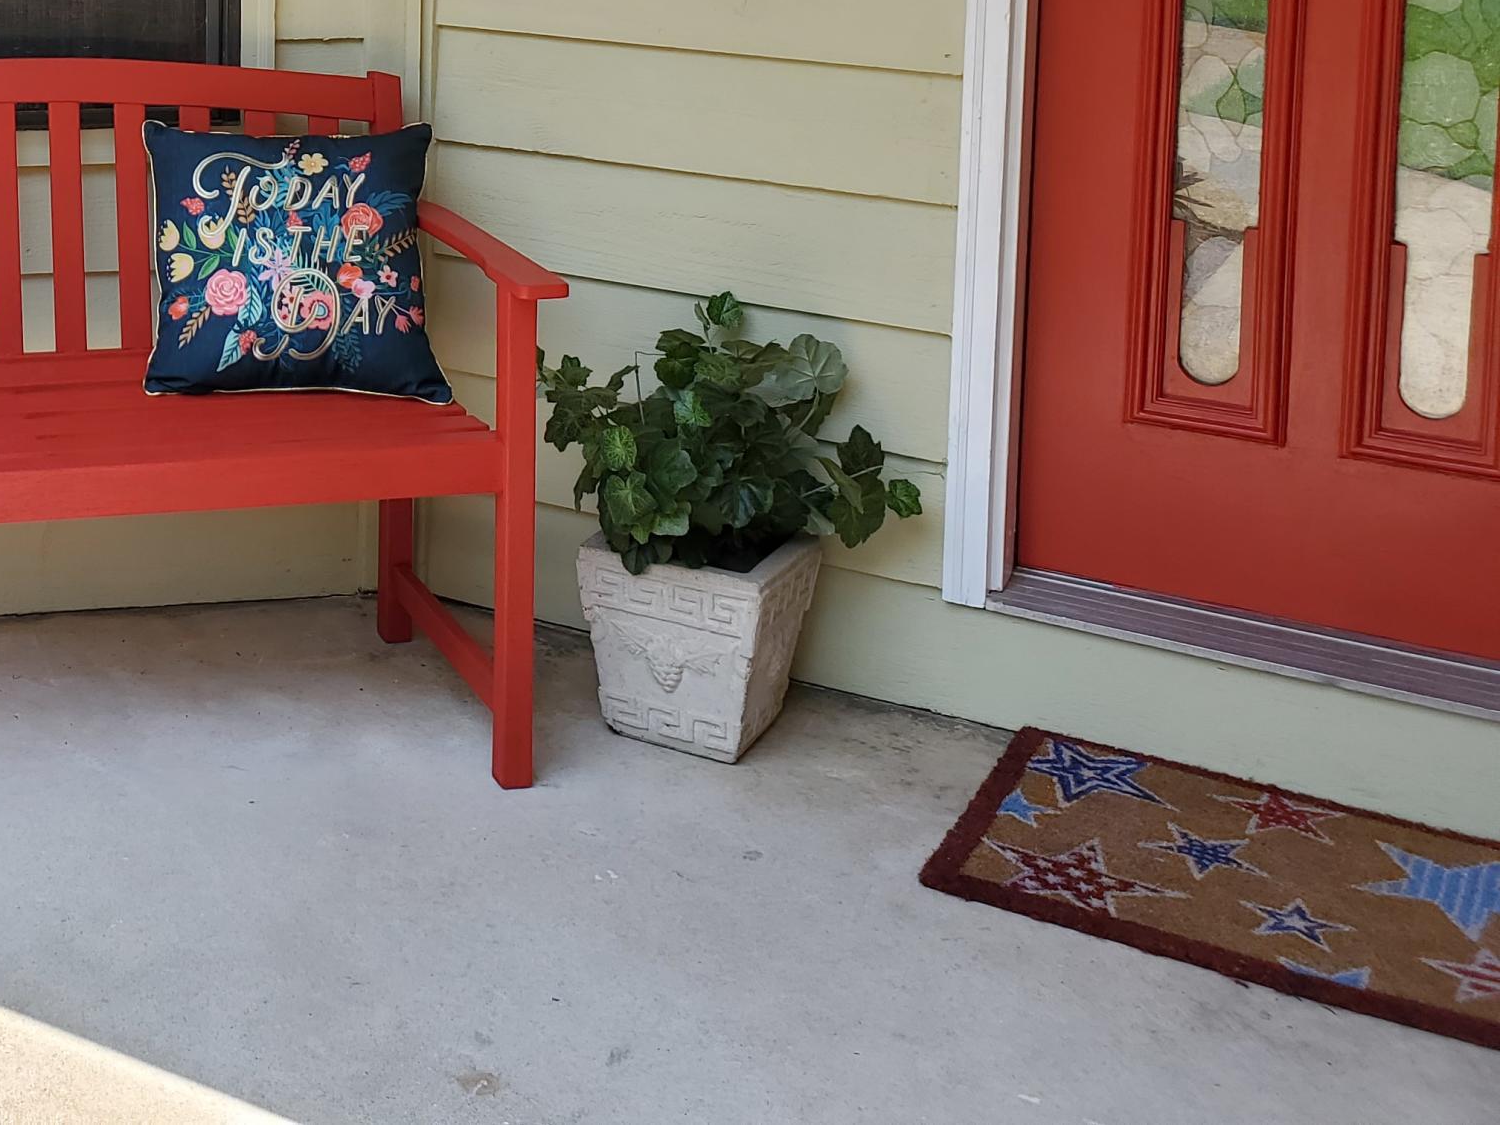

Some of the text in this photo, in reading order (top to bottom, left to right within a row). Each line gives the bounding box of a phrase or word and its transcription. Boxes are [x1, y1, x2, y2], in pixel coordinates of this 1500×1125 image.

[231, 224, 370, 267] IS THE
[252, 267, 396, 361] DAY
